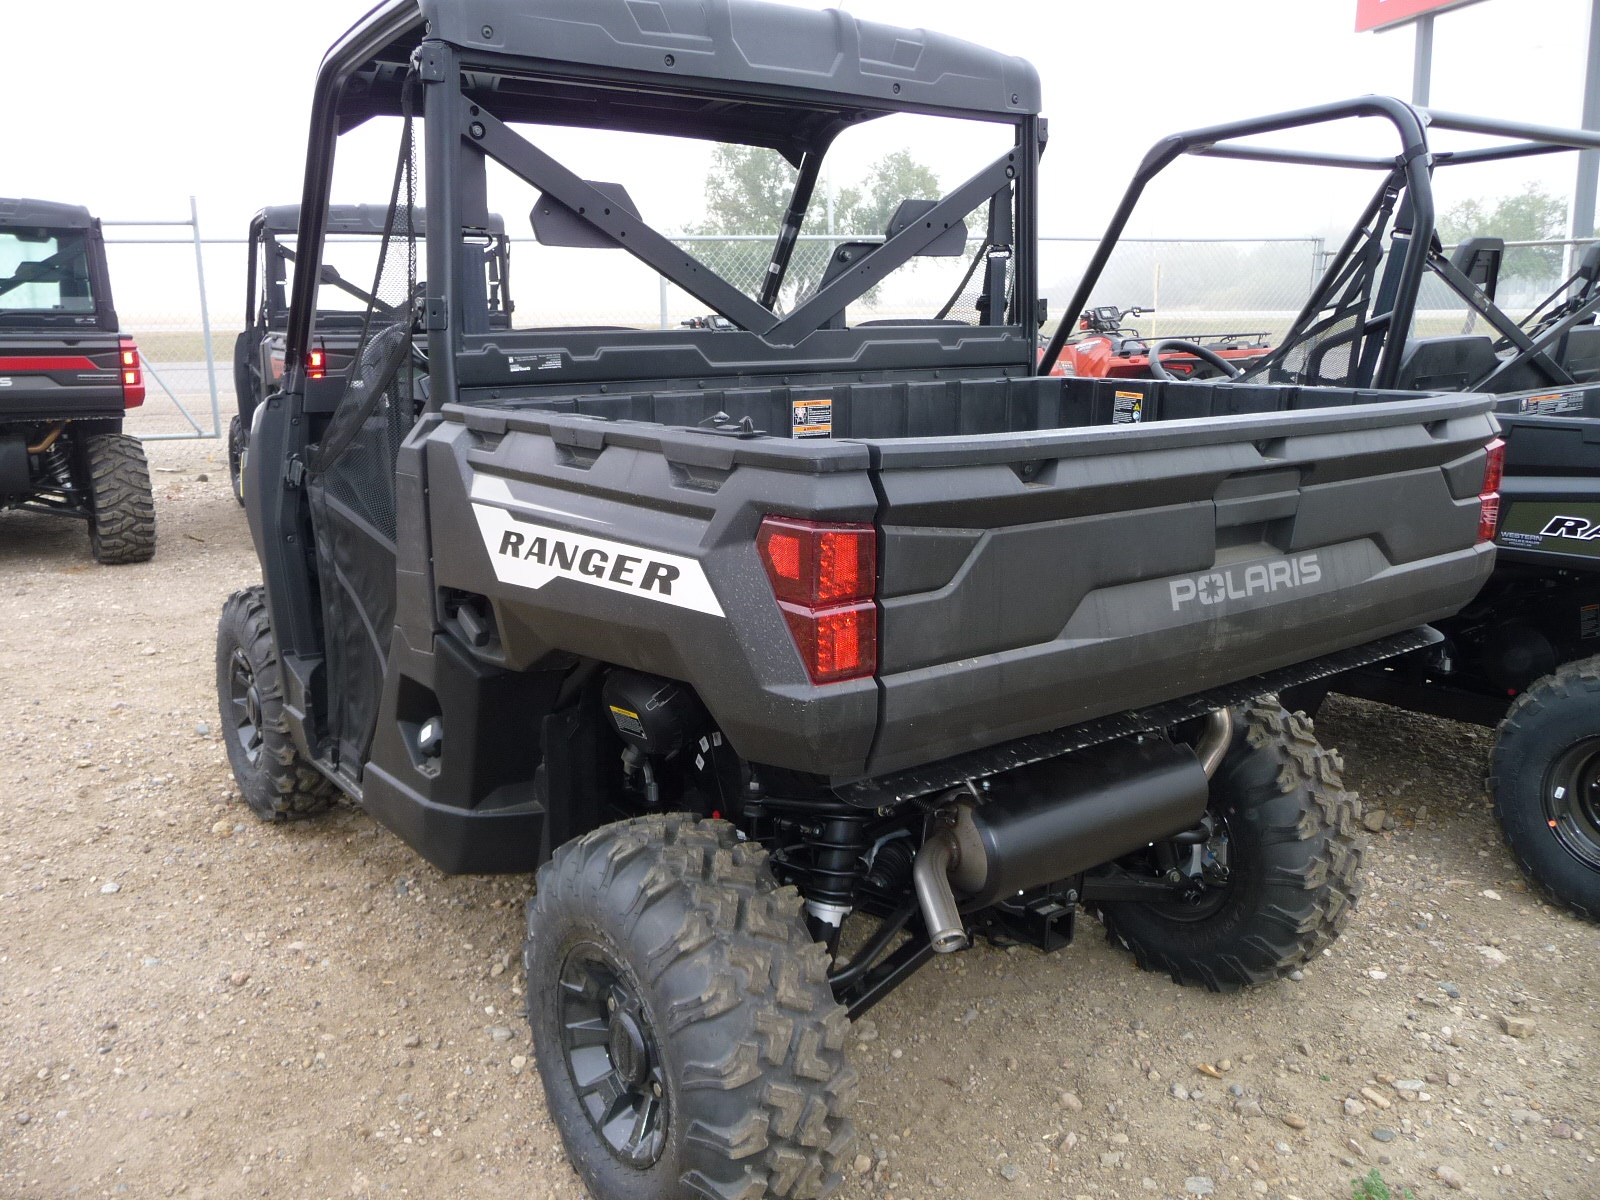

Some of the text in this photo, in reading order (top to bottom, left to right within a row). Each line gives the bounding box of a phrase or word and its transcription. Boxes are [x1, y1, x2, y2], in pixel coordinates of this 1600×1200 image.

[499, 530, 681, 596] RANGER
[1500, 531, 1543, 542] WESTERN
[1169, 554, 1322, 611] POLARIS
